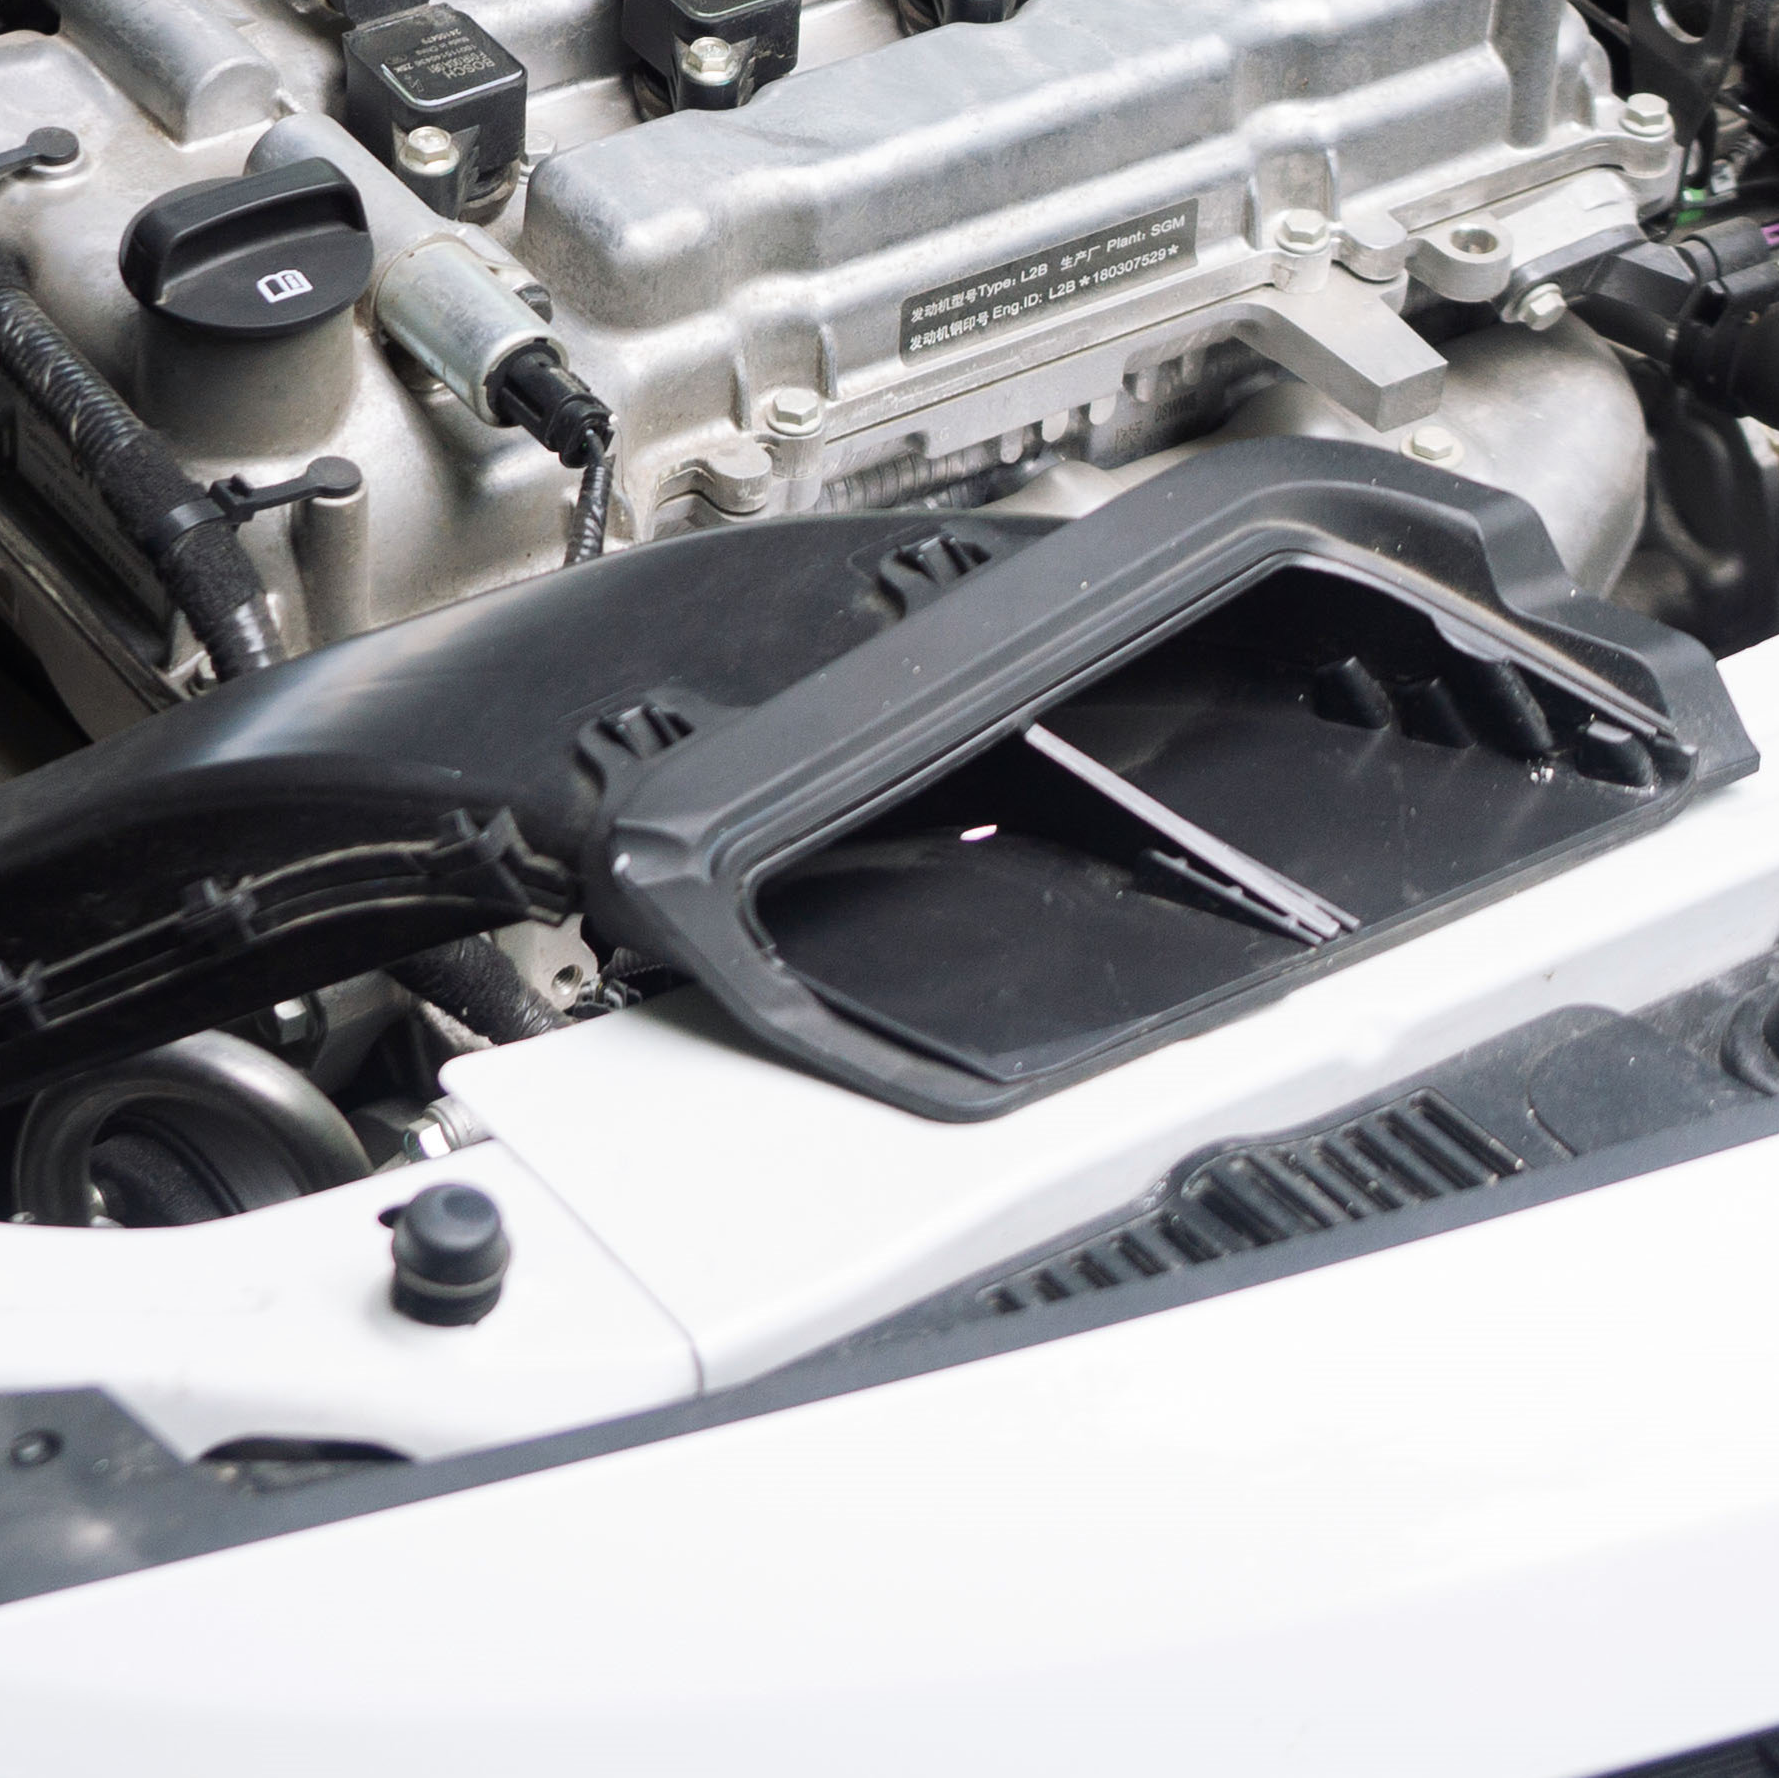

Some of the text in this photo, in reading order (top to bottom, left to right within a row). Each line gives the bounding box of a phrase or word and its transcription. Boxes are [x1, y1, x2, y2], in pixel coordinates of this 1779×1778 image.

[443, 57, 495, 80] BOSCH
[1020, 262, 1049, 283] L2B
[1060, 245, 1101, 272] 生产厂
[1107, 232, 1146, 253] Plant:
[1150, 214, 1186, 237] SGM
[909, 311, 989, 352] 发动机钢印号
[992, 293, 1043, 321] Eng.ID:
